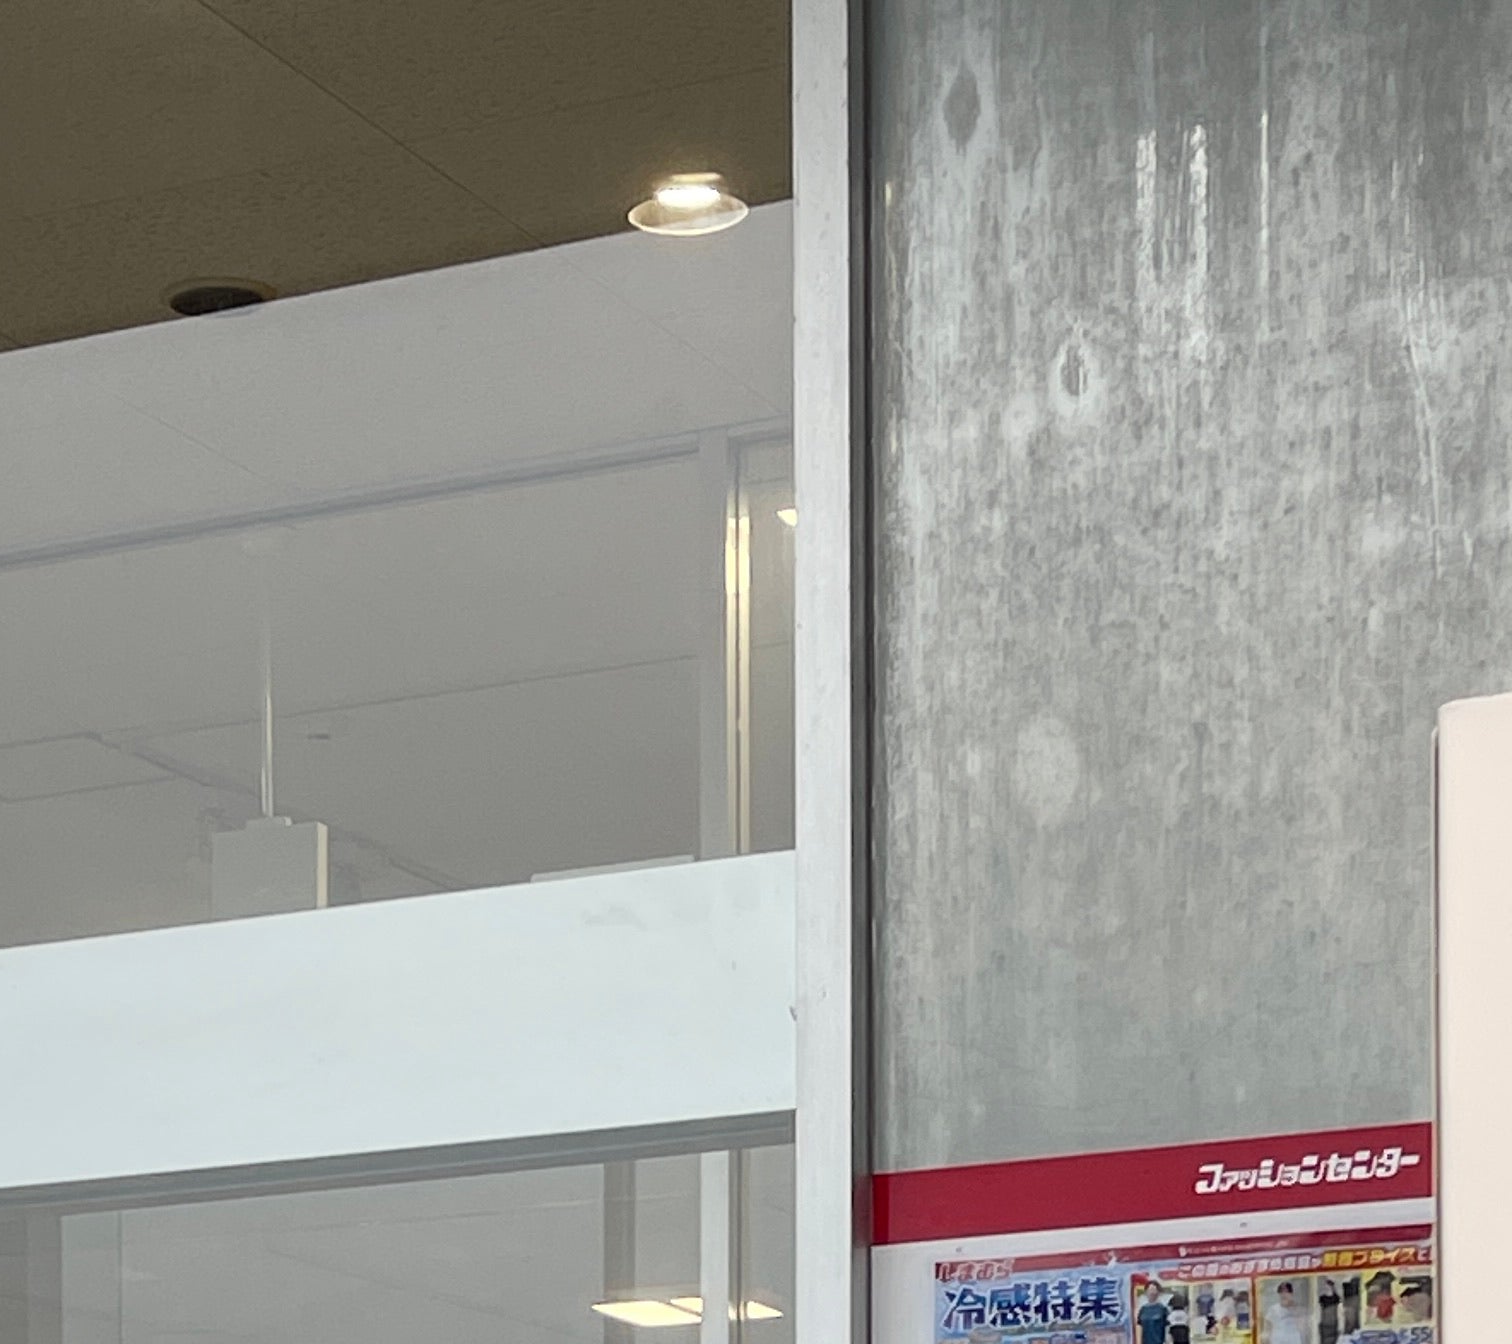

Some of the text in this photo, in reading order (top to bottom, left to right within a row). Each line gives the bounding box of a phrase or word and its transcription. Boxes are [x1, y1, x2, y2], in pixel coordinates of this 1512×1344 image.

[1195, 1147, 1420, 1194] ファッションセンター
[942, 1276, 1120, 1330] 冷感特集
